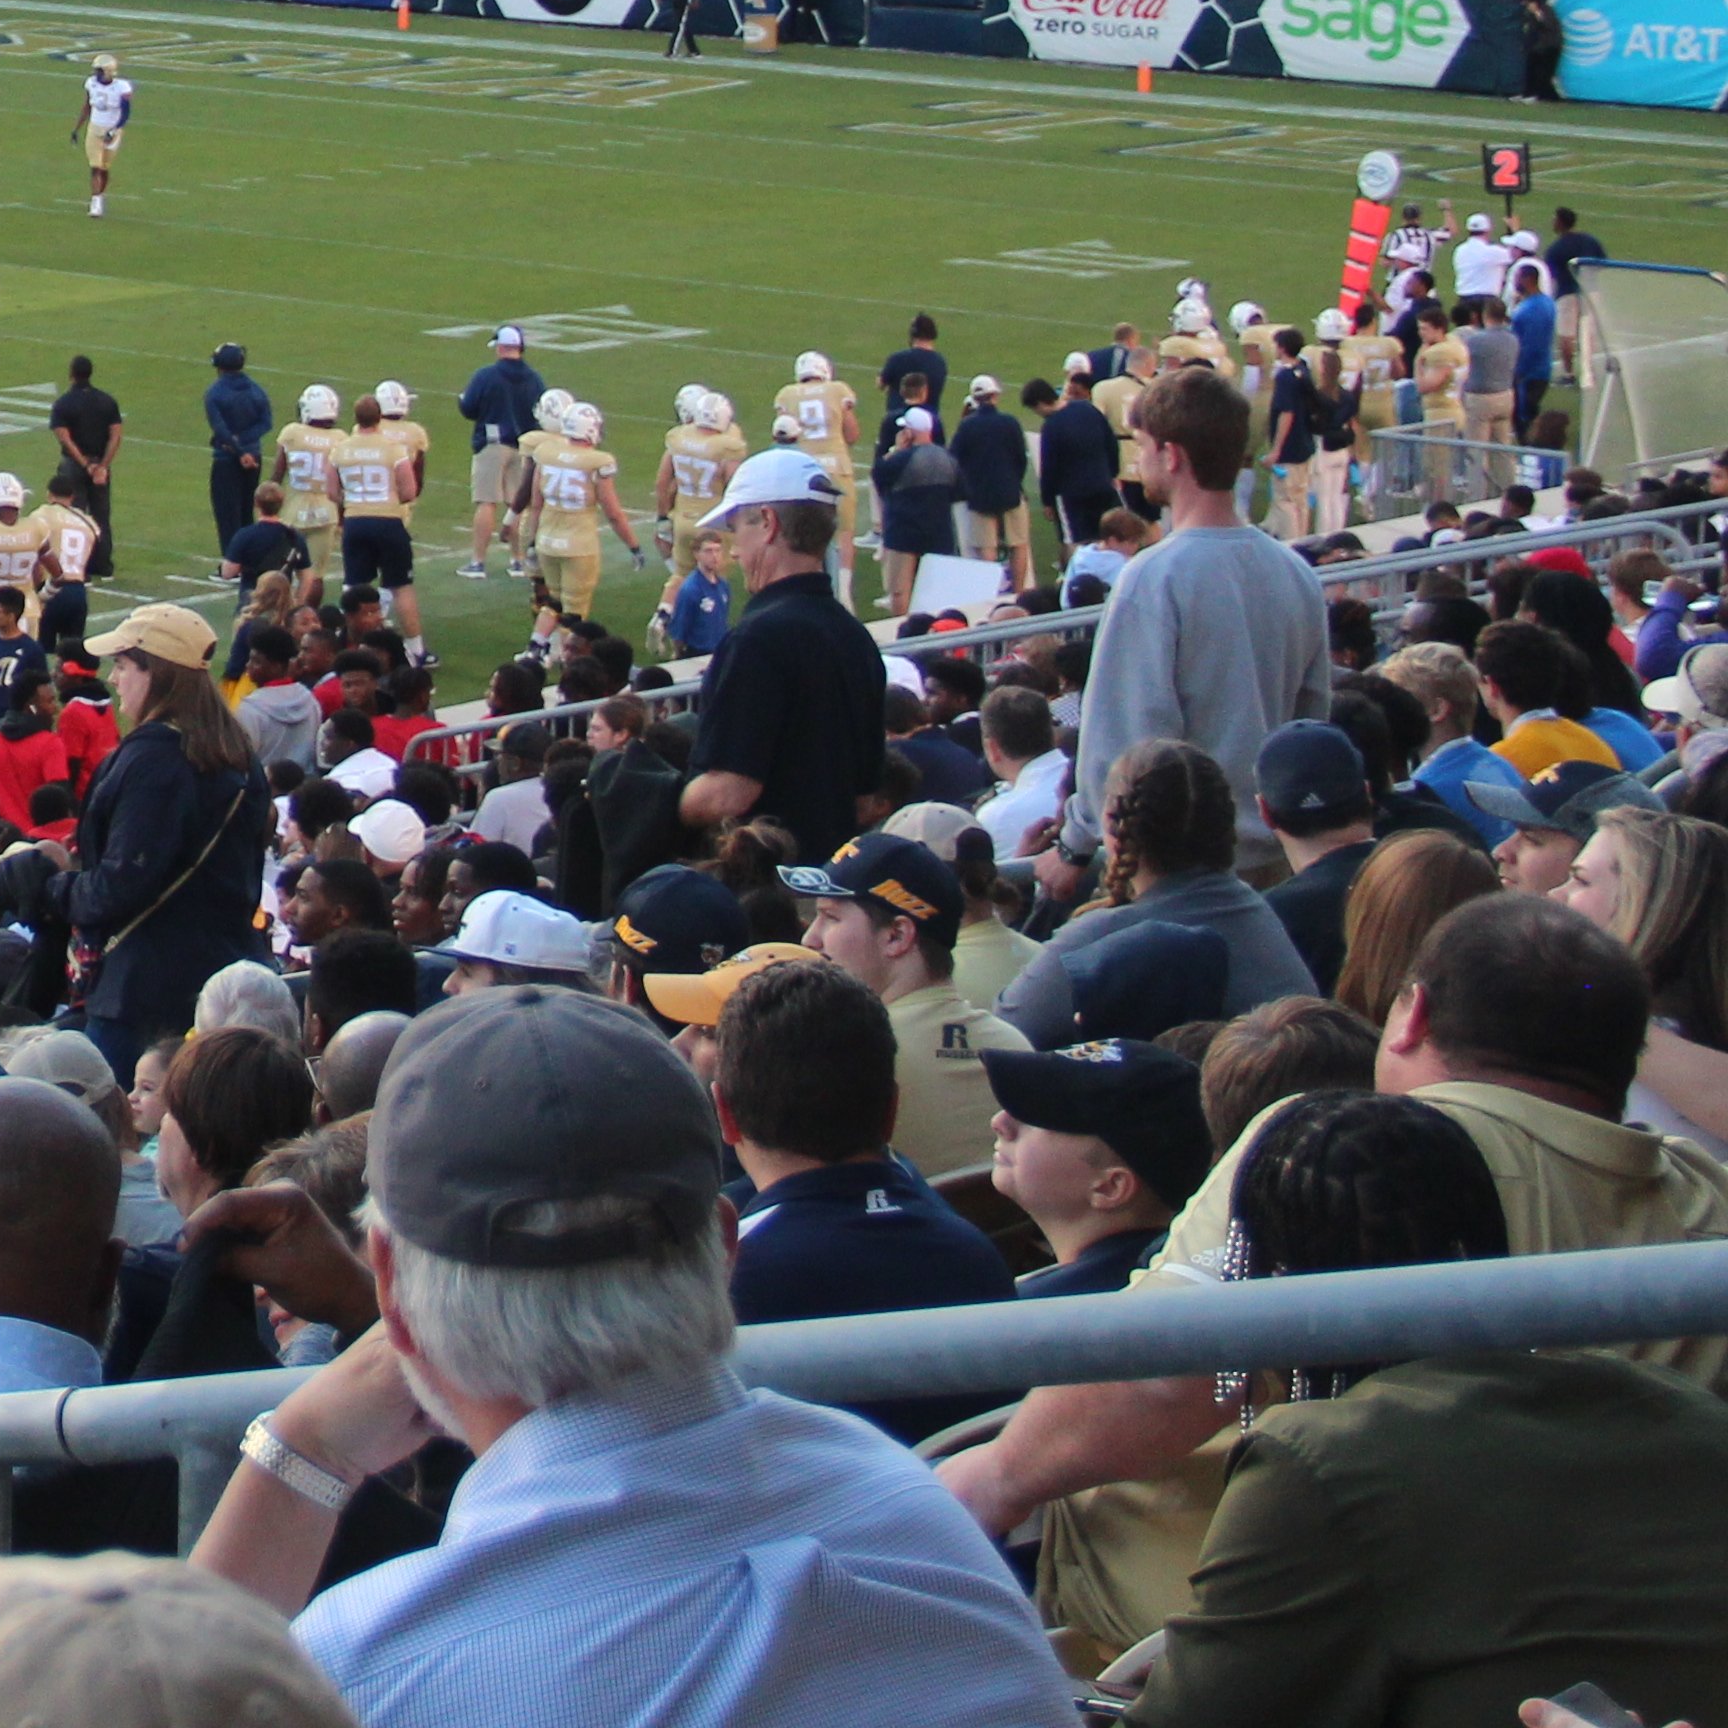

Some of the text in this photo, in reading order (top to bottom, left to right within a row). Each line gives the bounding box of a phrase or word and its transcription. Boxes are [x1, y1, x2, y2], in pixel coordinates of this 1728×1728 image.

[1034, 18, 1158, 40] zero SUGAR
[1624, 23, 1726, 62] AT&T
[1492, 148, 1520, 188] 2
[942, 1024, 969, 1049] R
[865, 1189, 889, 1209] R
